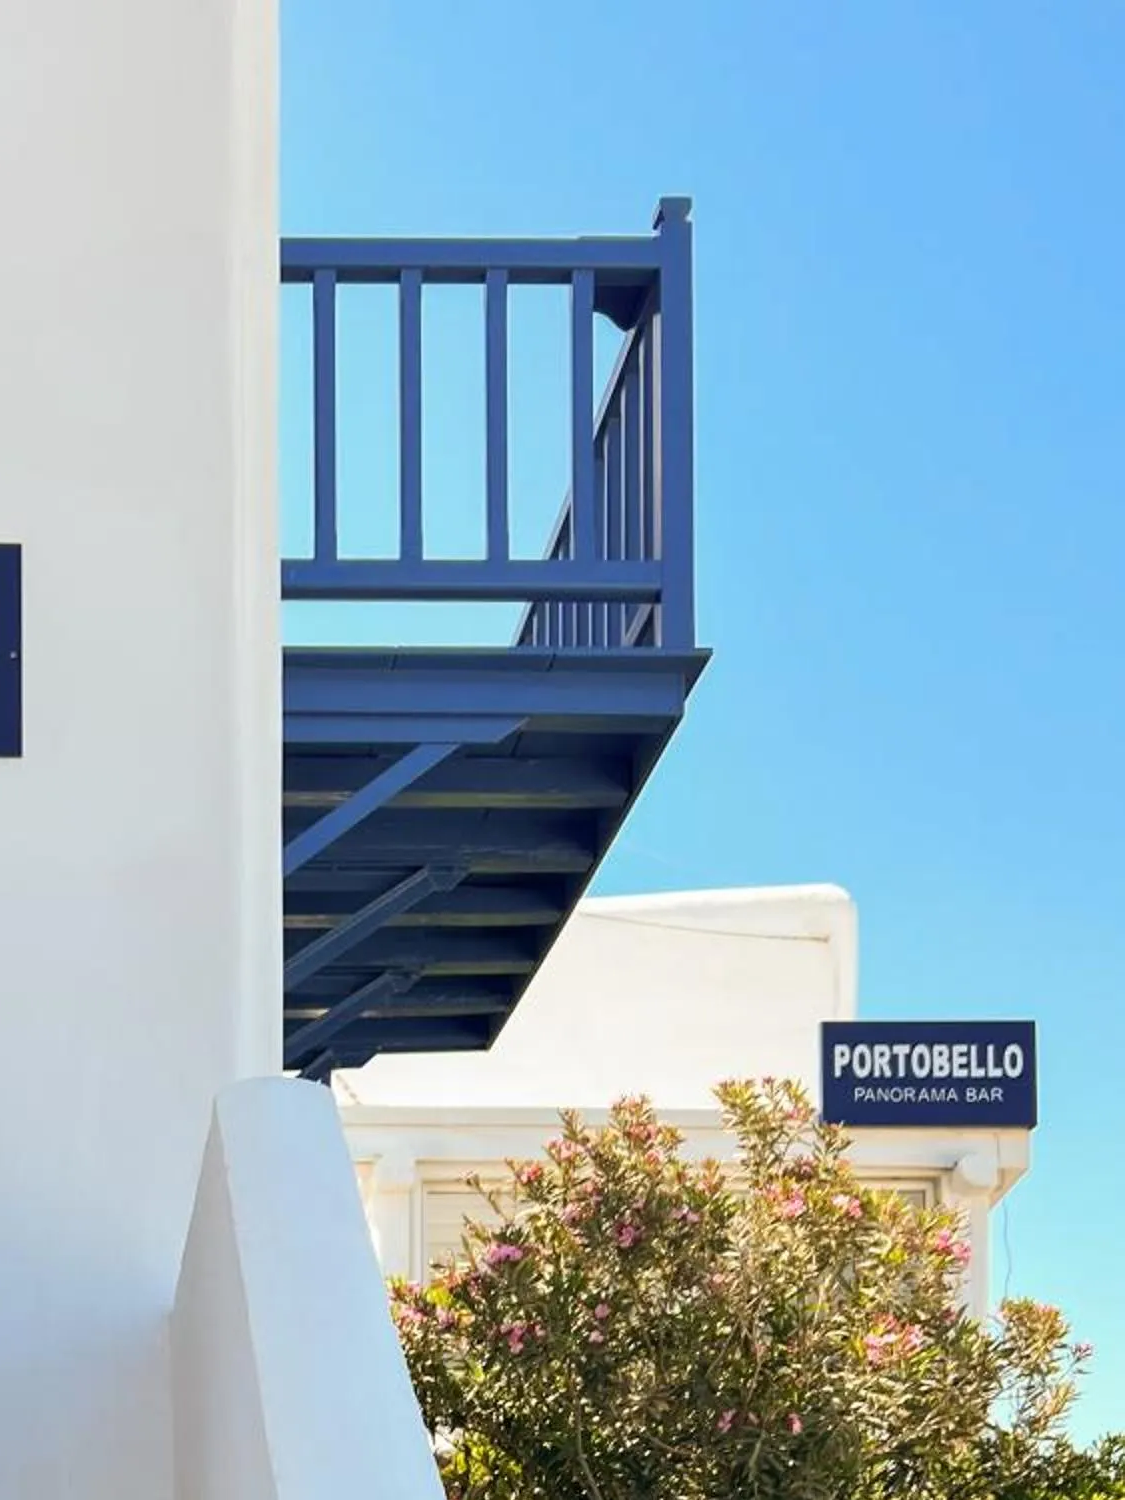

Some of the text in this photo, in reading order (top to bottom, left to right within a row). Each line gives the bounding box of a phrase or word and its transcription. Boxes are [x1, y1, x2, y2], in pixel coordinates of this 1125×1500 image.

[834, 1043, 1024, 1079] PORTOBELLO
[854, 1087, 1004, 1102] PANORAMA BAR
